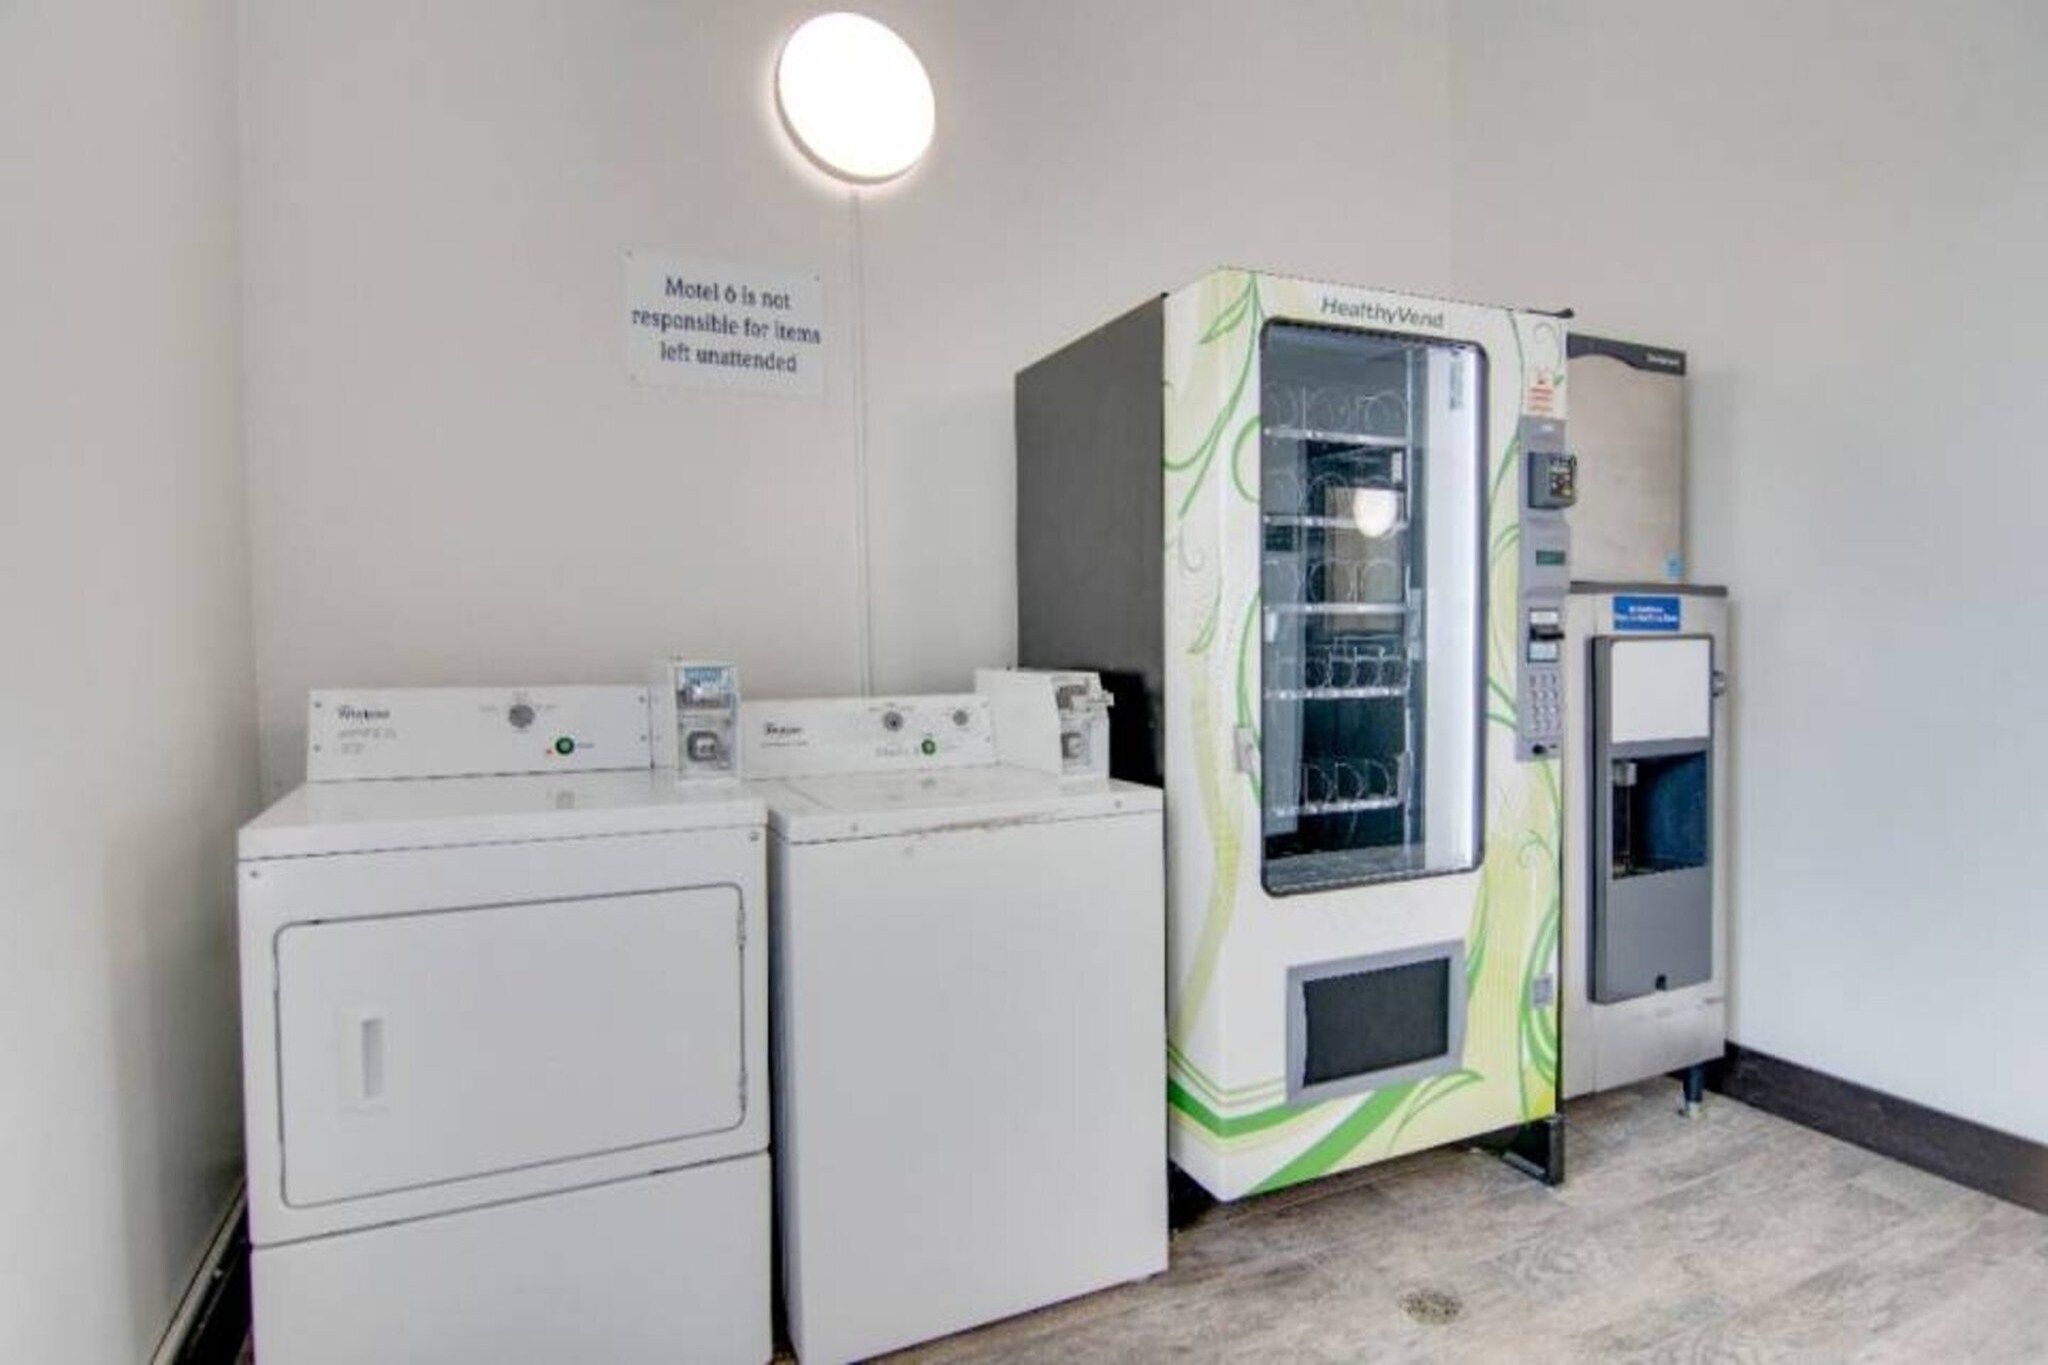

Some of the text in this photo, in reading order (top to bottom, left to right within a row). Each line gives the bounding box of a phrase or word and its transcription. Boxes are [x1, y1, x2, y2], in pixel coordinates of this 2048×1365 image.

[665, 276, 791, 310] Motel 6 is not
[632, 308, 821, 344] responsible for items
[1320, 297, 1444, 328] HealthyVend
[661, 341, 797, 373] left unattended
